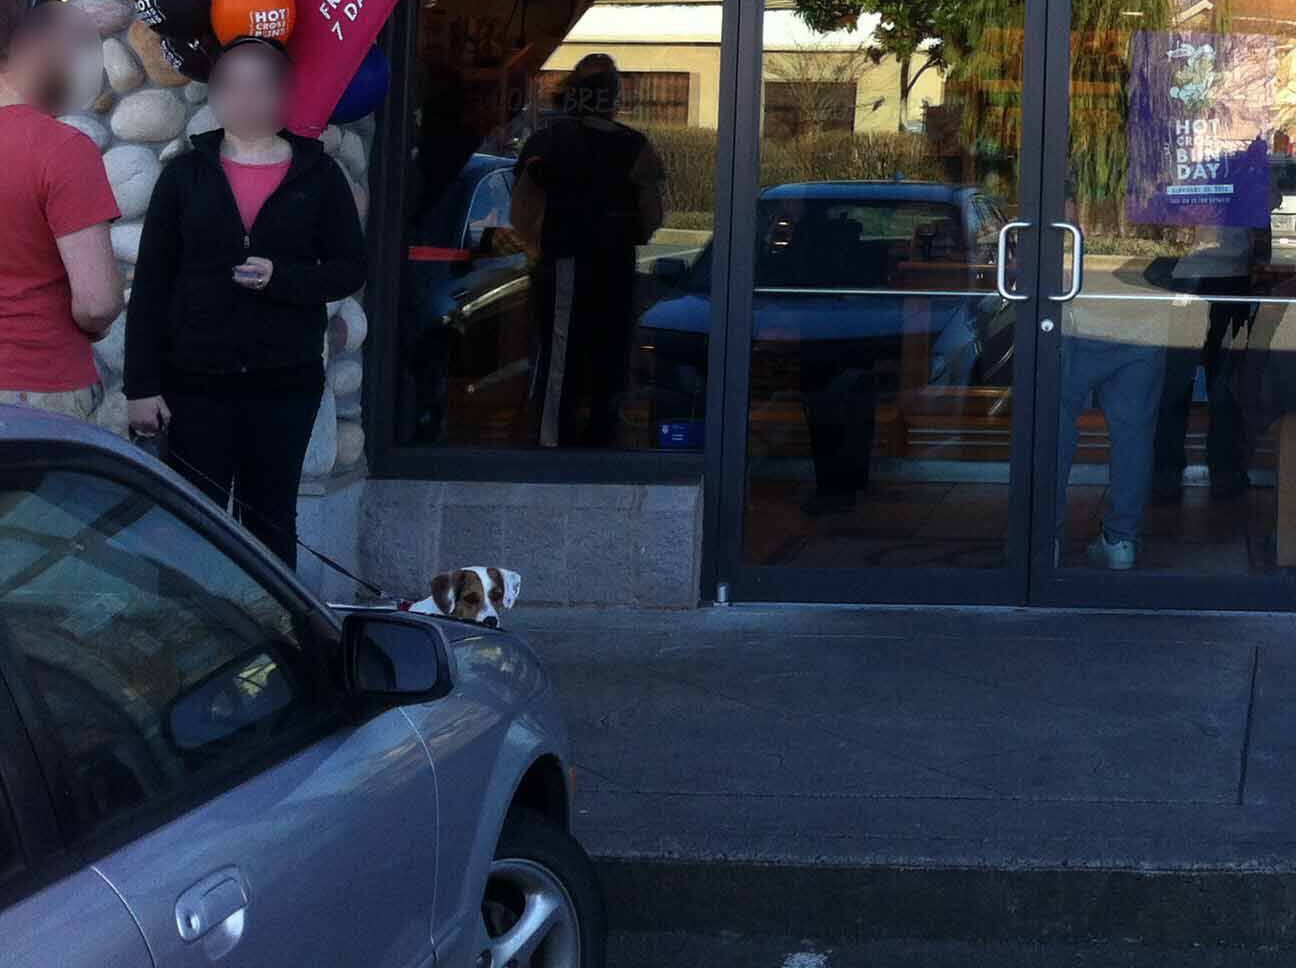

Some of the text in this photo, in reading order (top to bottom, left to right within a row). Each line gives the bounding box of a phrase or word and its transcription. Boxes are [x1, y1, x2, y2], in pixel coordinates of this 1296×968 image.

[255, 8, 286, 23] HOT
[331, 21, 343, 41] 7
[1176, 119, 1219, 135] HOT
[1177, 163, 1220, 180] DAY
